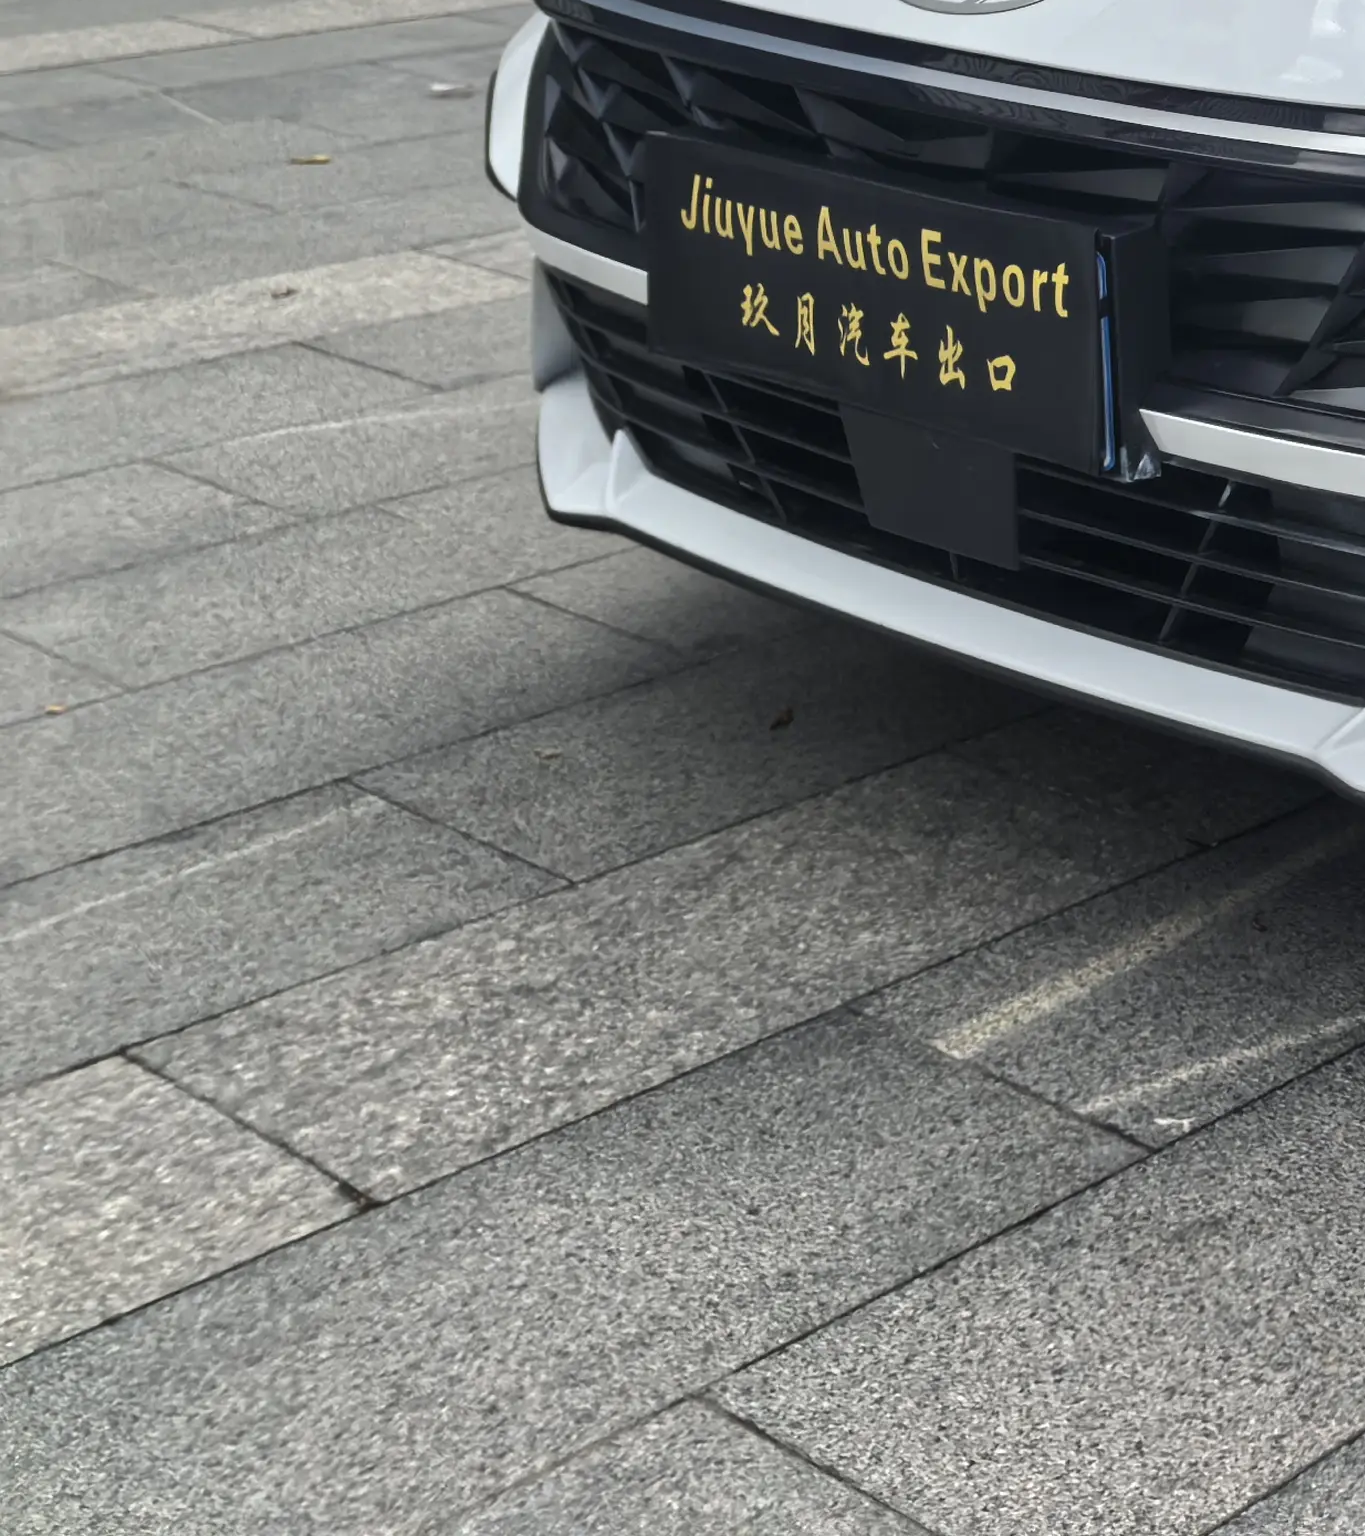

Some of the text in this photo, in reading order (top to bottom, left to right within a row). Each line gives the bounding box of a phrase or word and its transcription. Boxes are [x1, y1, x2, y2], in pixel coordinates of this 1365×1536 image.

[680, 173, 1069, 319] Jiuyue Auto Export
[739, 282, 1017, 393] 玖月汽车出口
